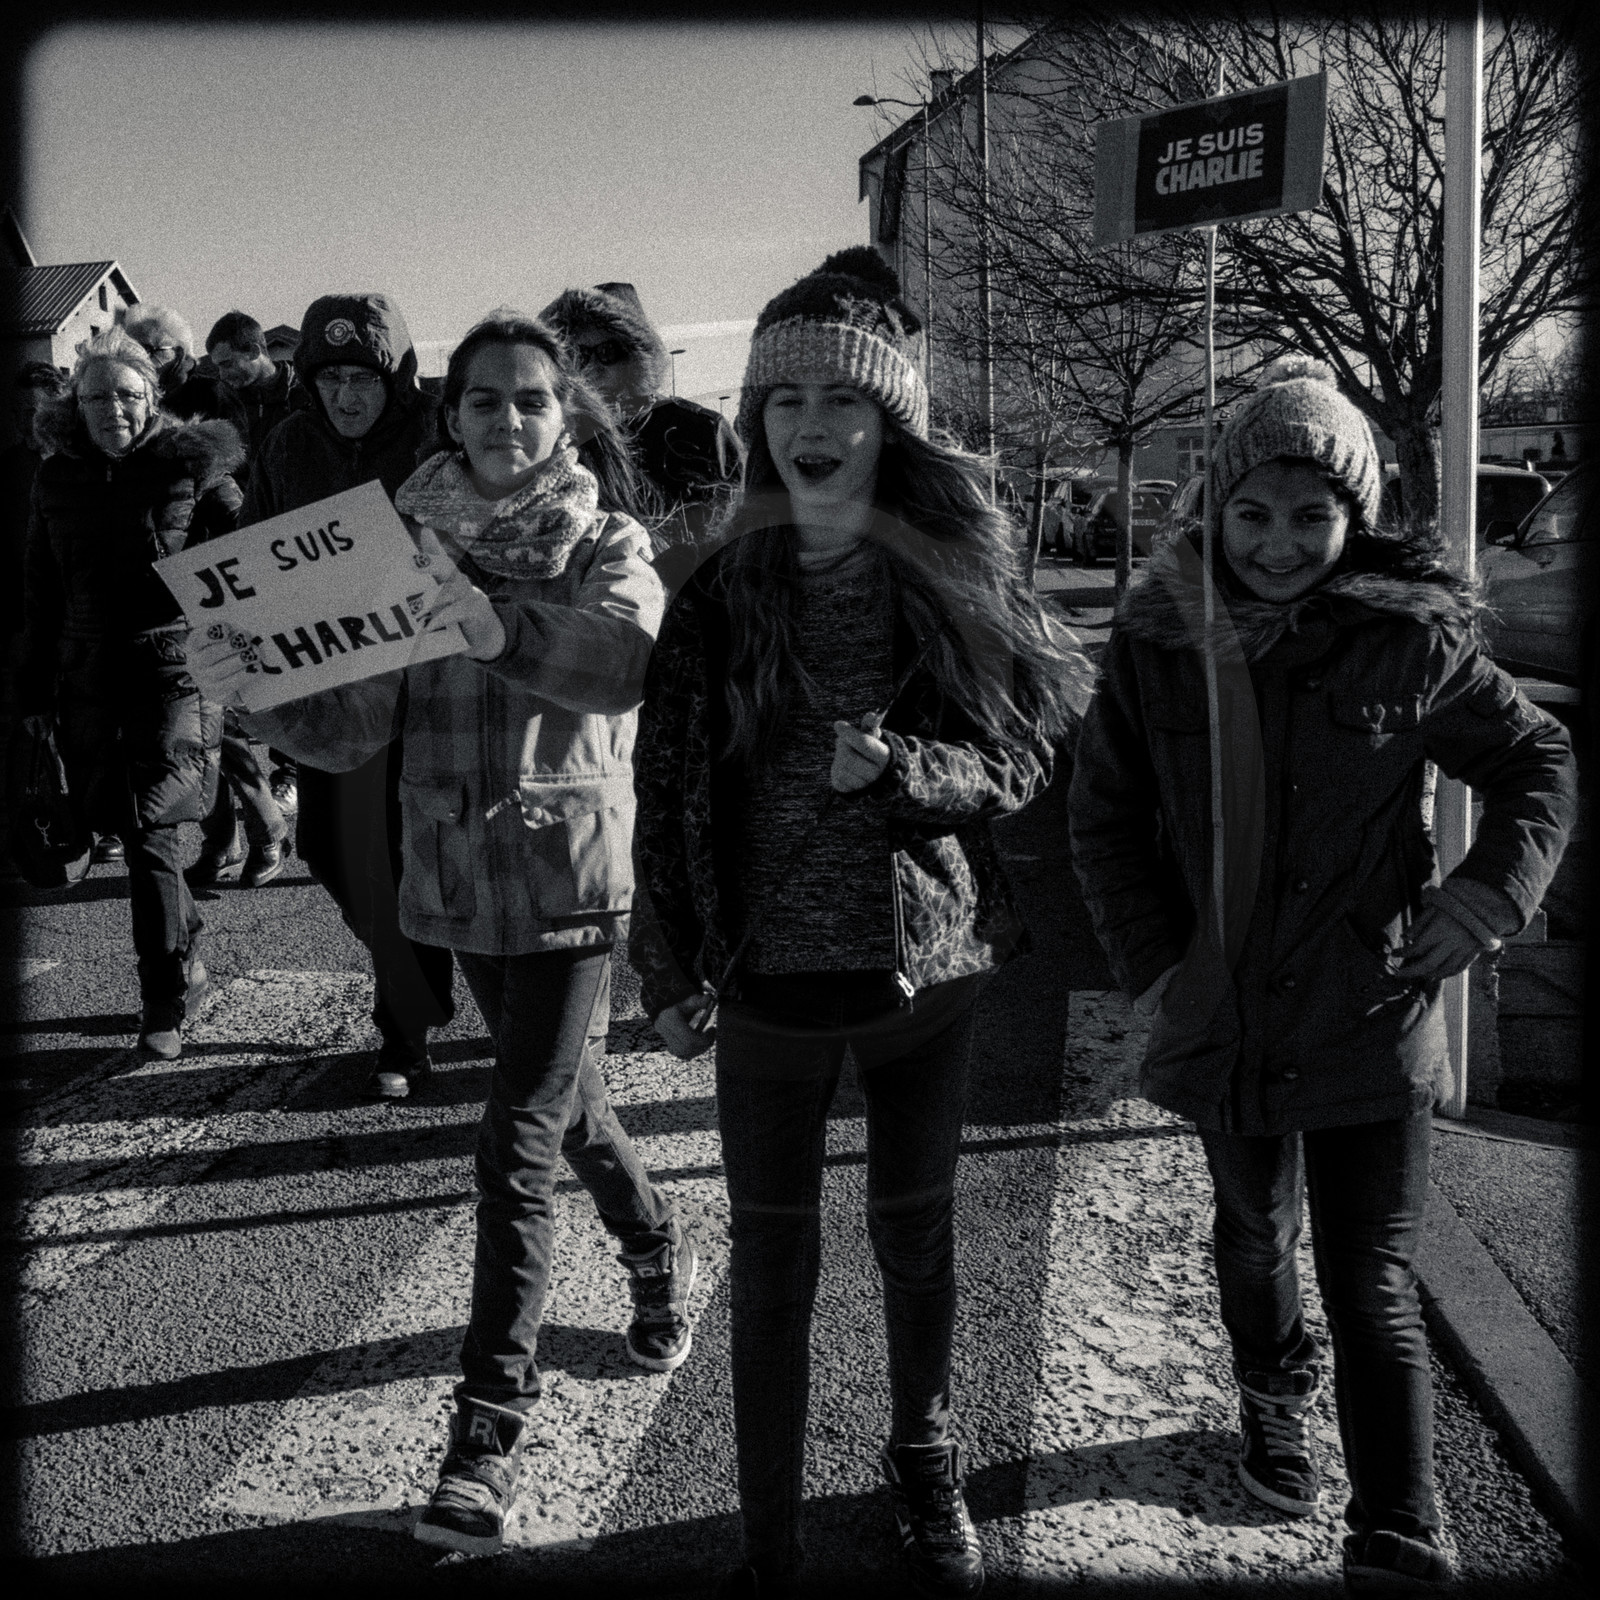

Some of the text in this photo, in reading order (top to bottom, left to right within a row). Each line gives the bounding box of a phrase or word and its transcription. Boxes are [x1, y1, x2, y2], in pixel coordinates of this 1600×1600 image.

[1158, 123, 1264, 164] JE SUIS
[1155, 148, 1264, 195] CHARLIE
[194, 520, 354, 608] JE SUIS
[469, 1415, 493, 1444] R
